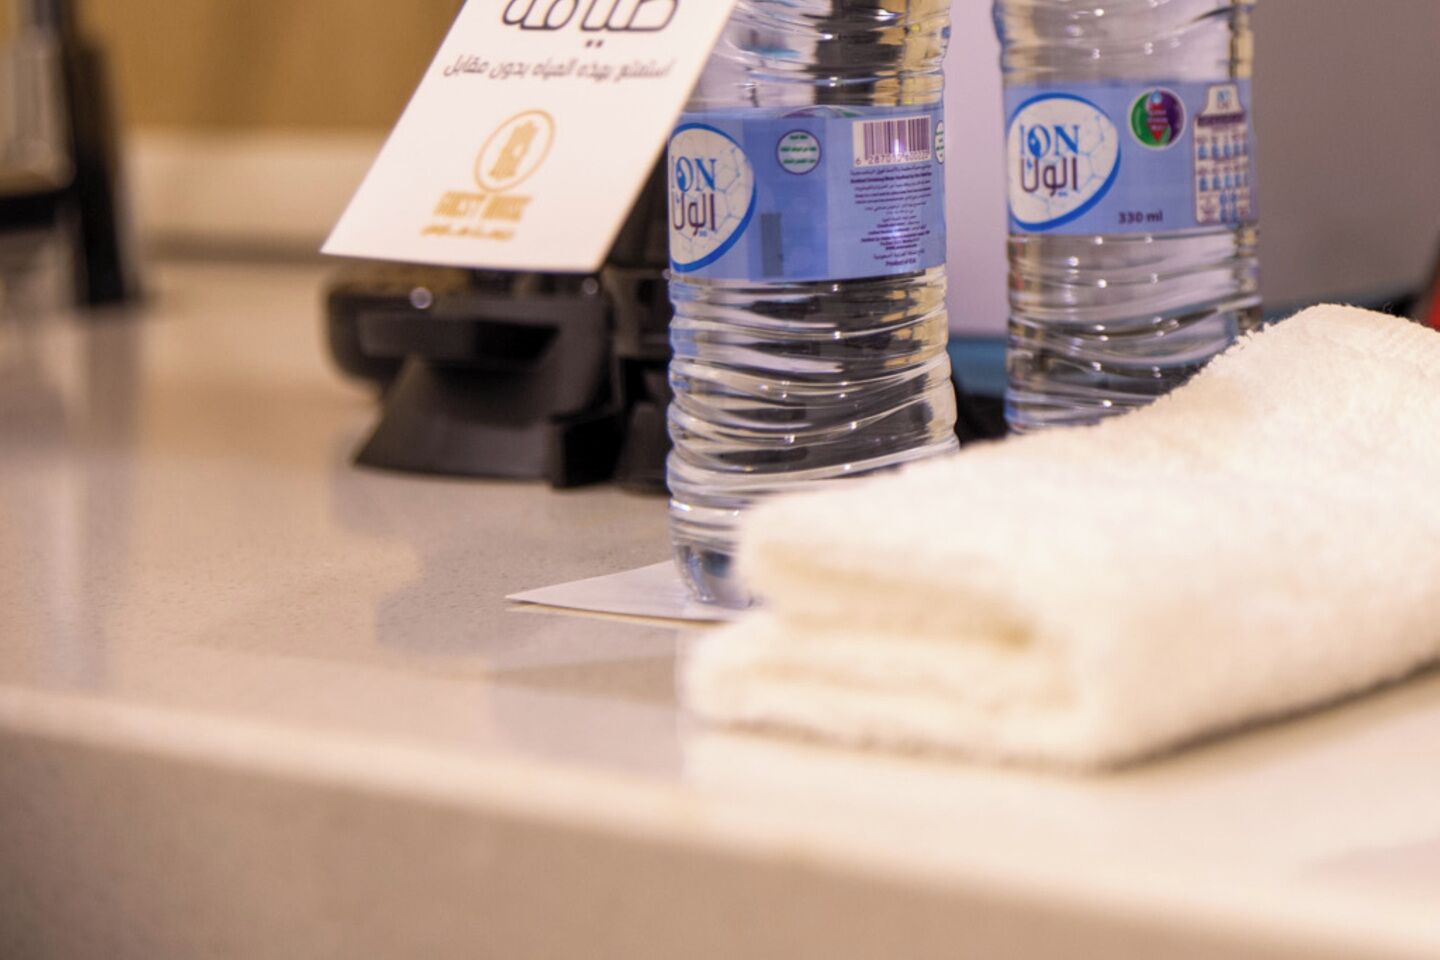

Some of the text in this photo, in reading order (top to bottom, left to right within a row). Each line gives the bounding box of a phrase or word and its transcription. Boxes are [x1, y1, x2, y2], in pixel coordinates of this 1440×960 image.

[443, 53, 490, 78] مقابل
[489, 59, 529, 80] بدون
[1019, 123, 1081, 159] ION
[1118, 209, 1164, 225] 330 ml
